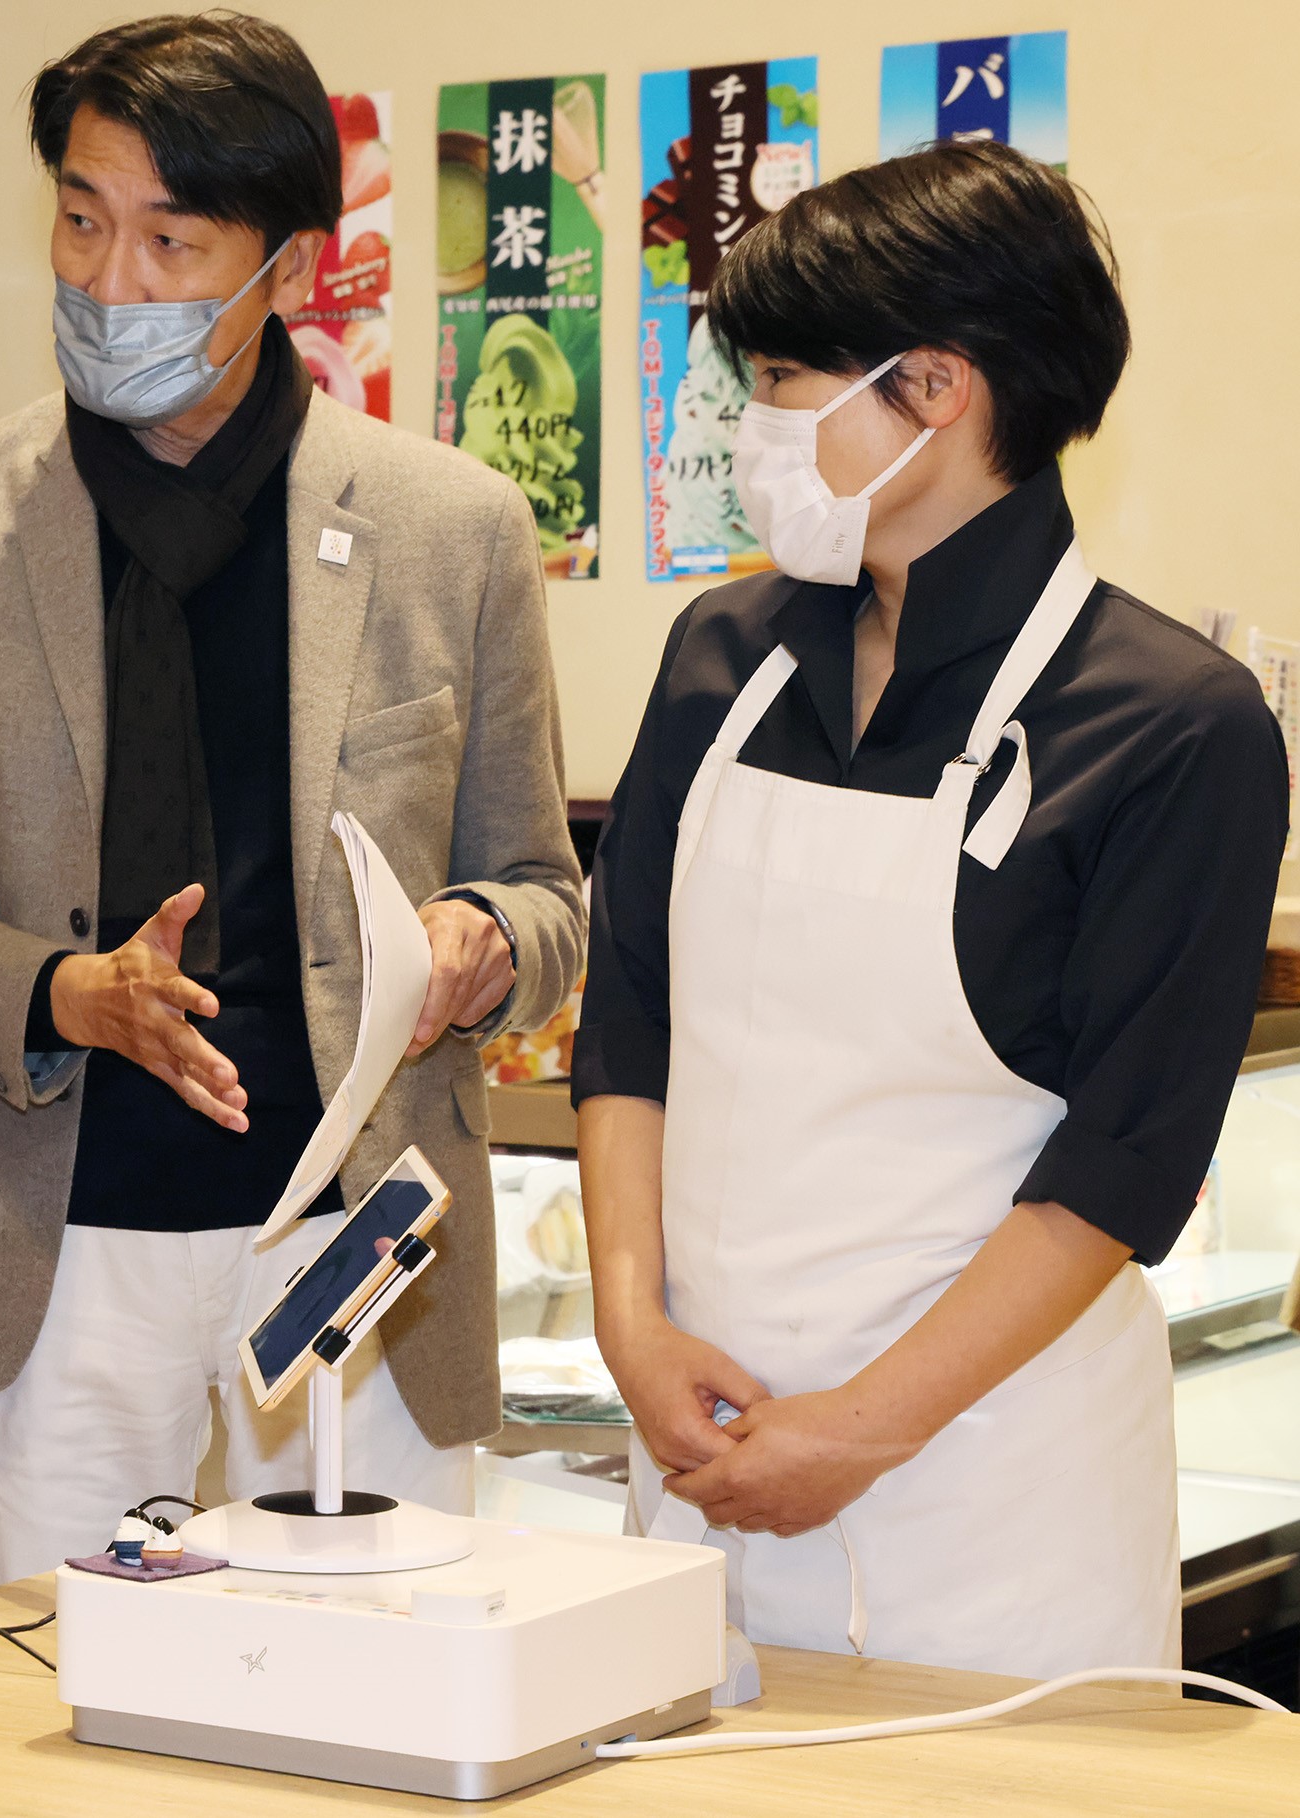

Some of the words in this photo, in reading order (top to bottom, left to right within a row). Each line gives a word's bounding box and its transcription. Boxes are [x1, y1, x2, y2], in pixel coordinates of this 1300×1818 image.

[941, 53, 1005, 142] バ
[491, 108, 549, 271] 抹茶
[496, 413, 572, 445] 440円
